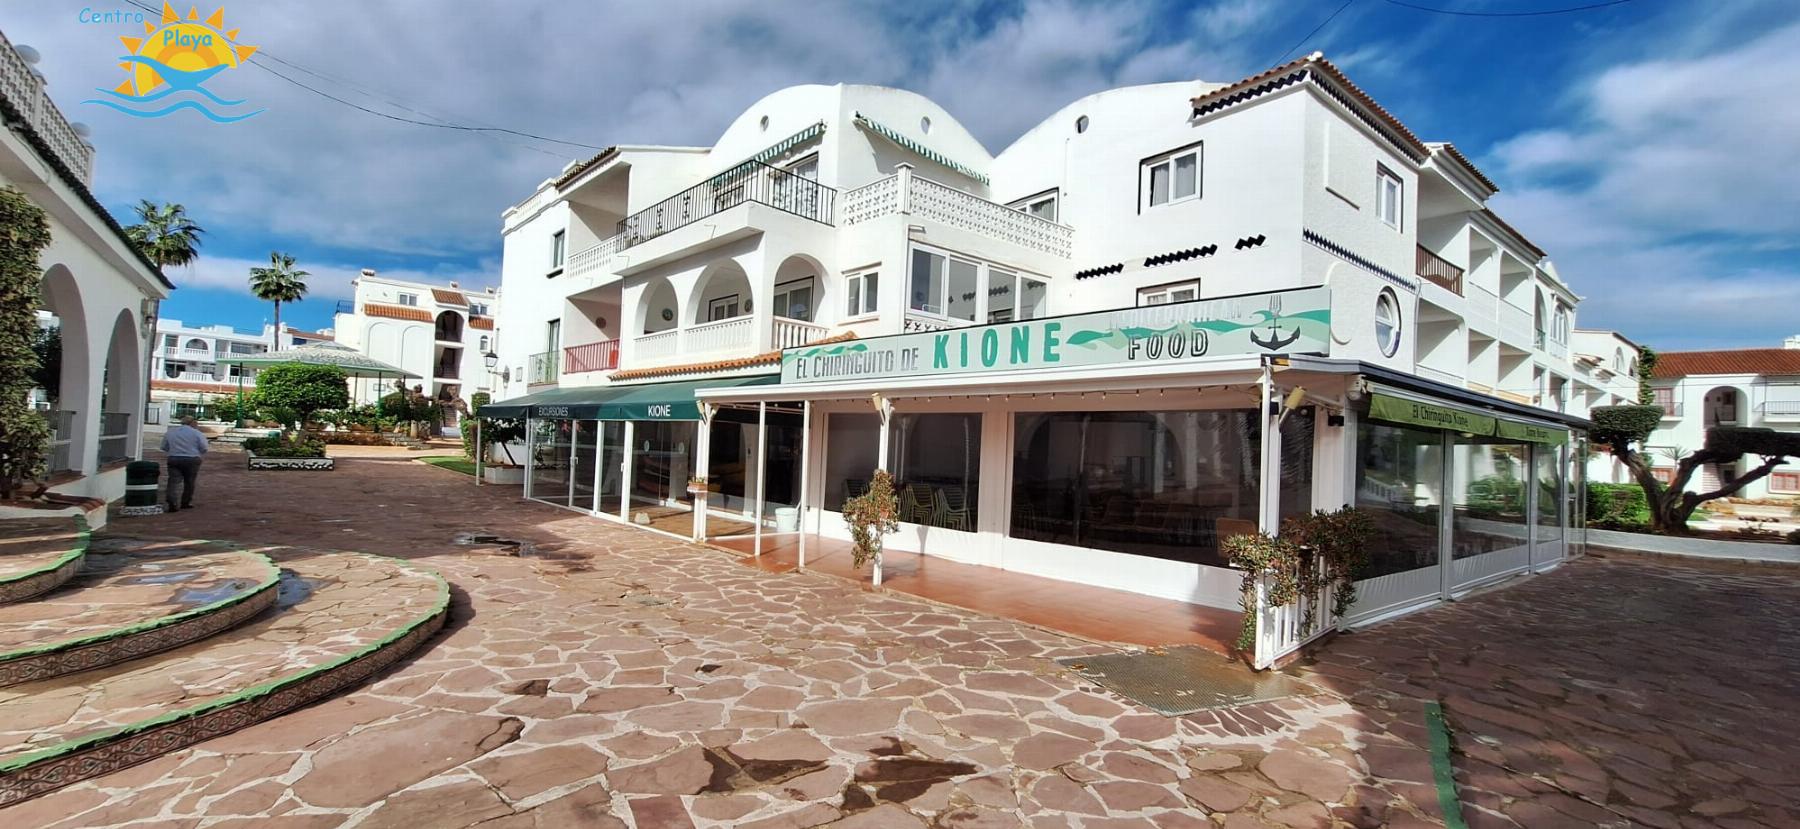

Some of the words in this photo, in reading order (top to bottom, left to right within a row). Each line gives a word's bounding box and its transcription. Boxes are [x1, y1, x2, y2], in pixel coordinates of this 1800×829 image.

[796, 357, 808, 380] EL
[813, 350, 894, 378] CHIRINGUITO
[901, 347, 919, 371] DE
[933, 322, 1061, 369] KIONE
[1128, 328, 1208, 360] FOOD
[648, 404, 671, 417] KIONE
[1412, 404, 1420, 419] El
[1421, 406, 1453, 426] Chiringuito
